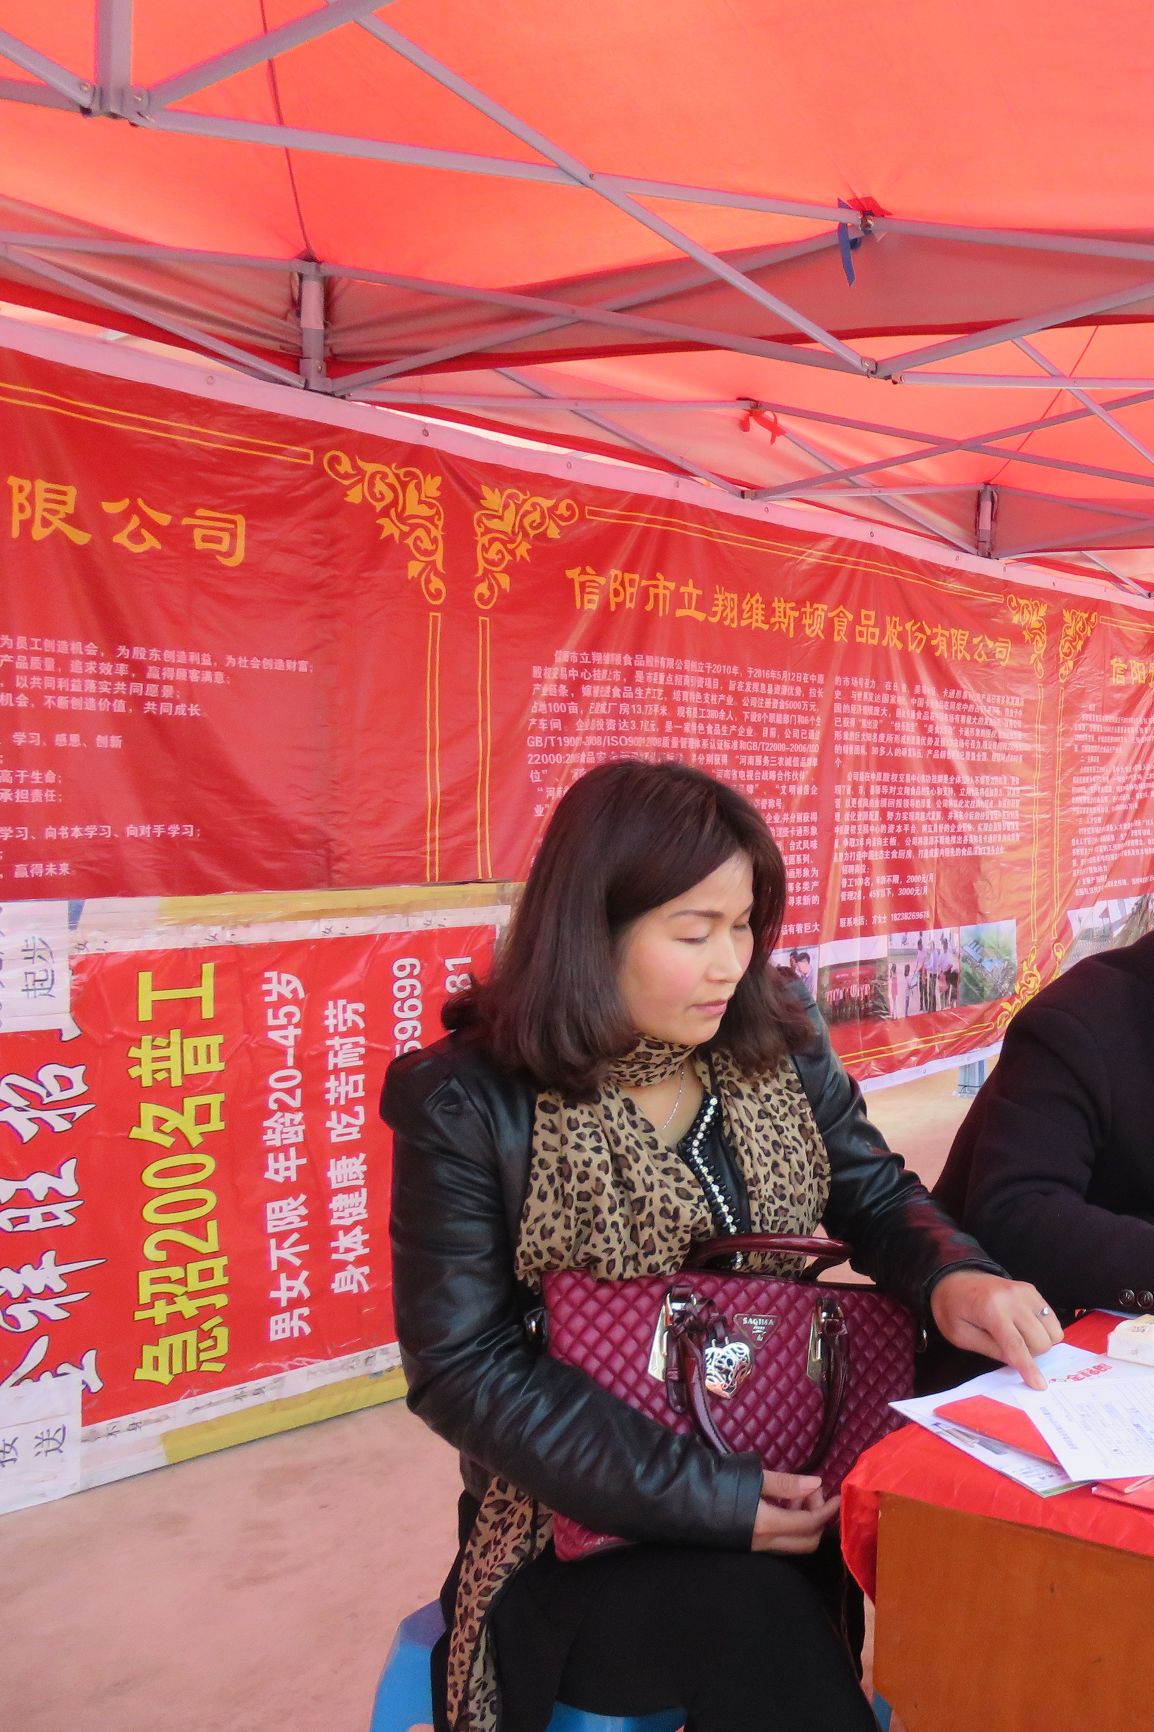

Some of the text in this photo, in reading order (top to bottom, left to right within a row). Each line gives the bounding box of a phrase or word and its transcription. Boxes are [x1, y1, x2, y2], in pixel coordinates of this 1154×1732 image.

[6, 475, 248, 568] 限公司
[324, 999, 368, 1143] 吃苦耐劳
[128, 962, 230, 1387] 急招200名普工
[328, 1153, 371, 1297] 身体健康
[267, 1193, 312, 1343] 男女不限
